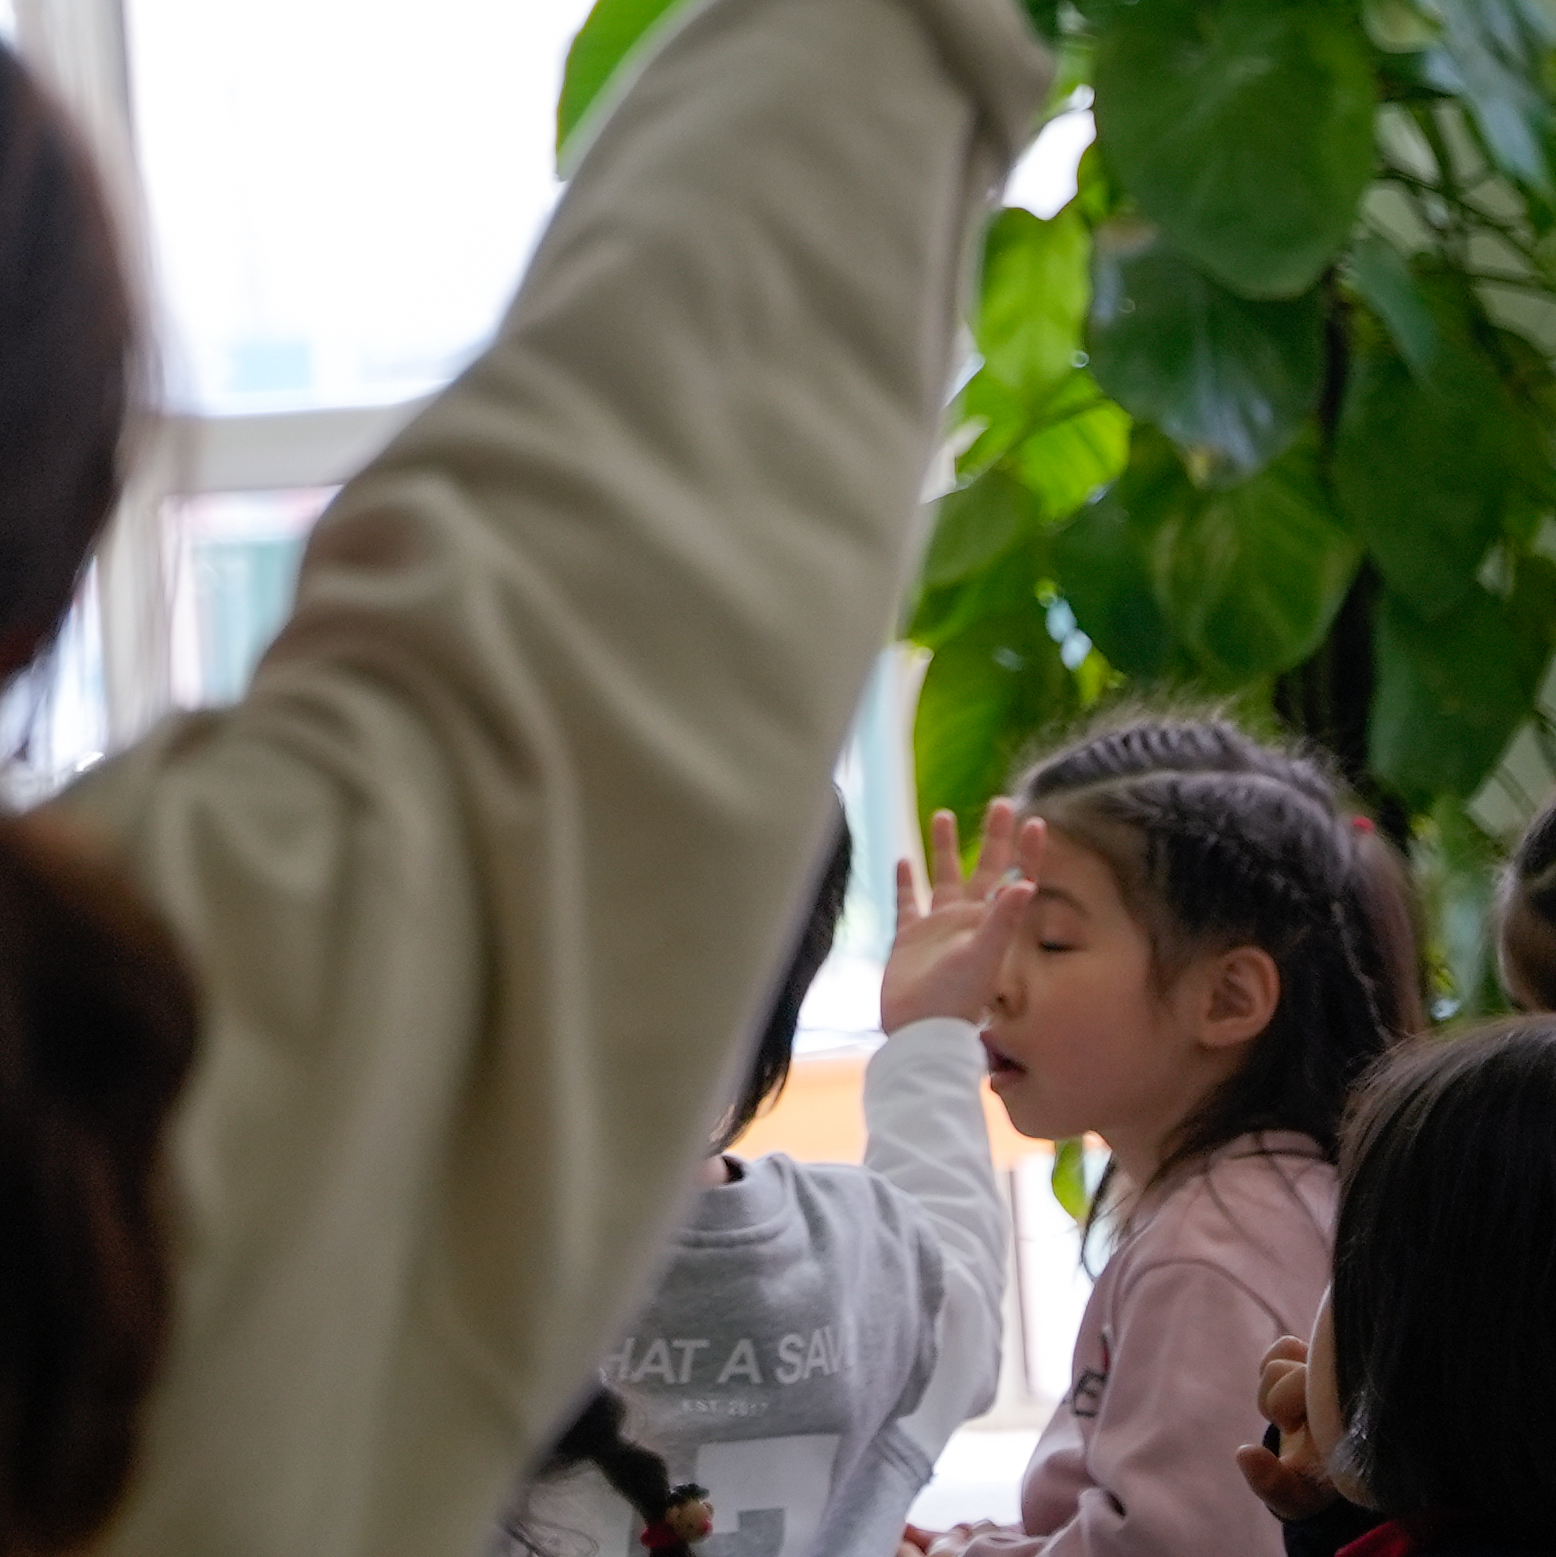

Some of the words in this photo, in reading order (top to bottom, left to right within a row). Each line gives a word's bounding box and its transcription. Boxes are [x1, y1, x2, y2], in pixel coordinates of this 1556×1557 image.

[599, 1337, 711, 1386] HAT
[717, 1337, 764, 1385] A
[774, 1325, 852, 1385] SAV
